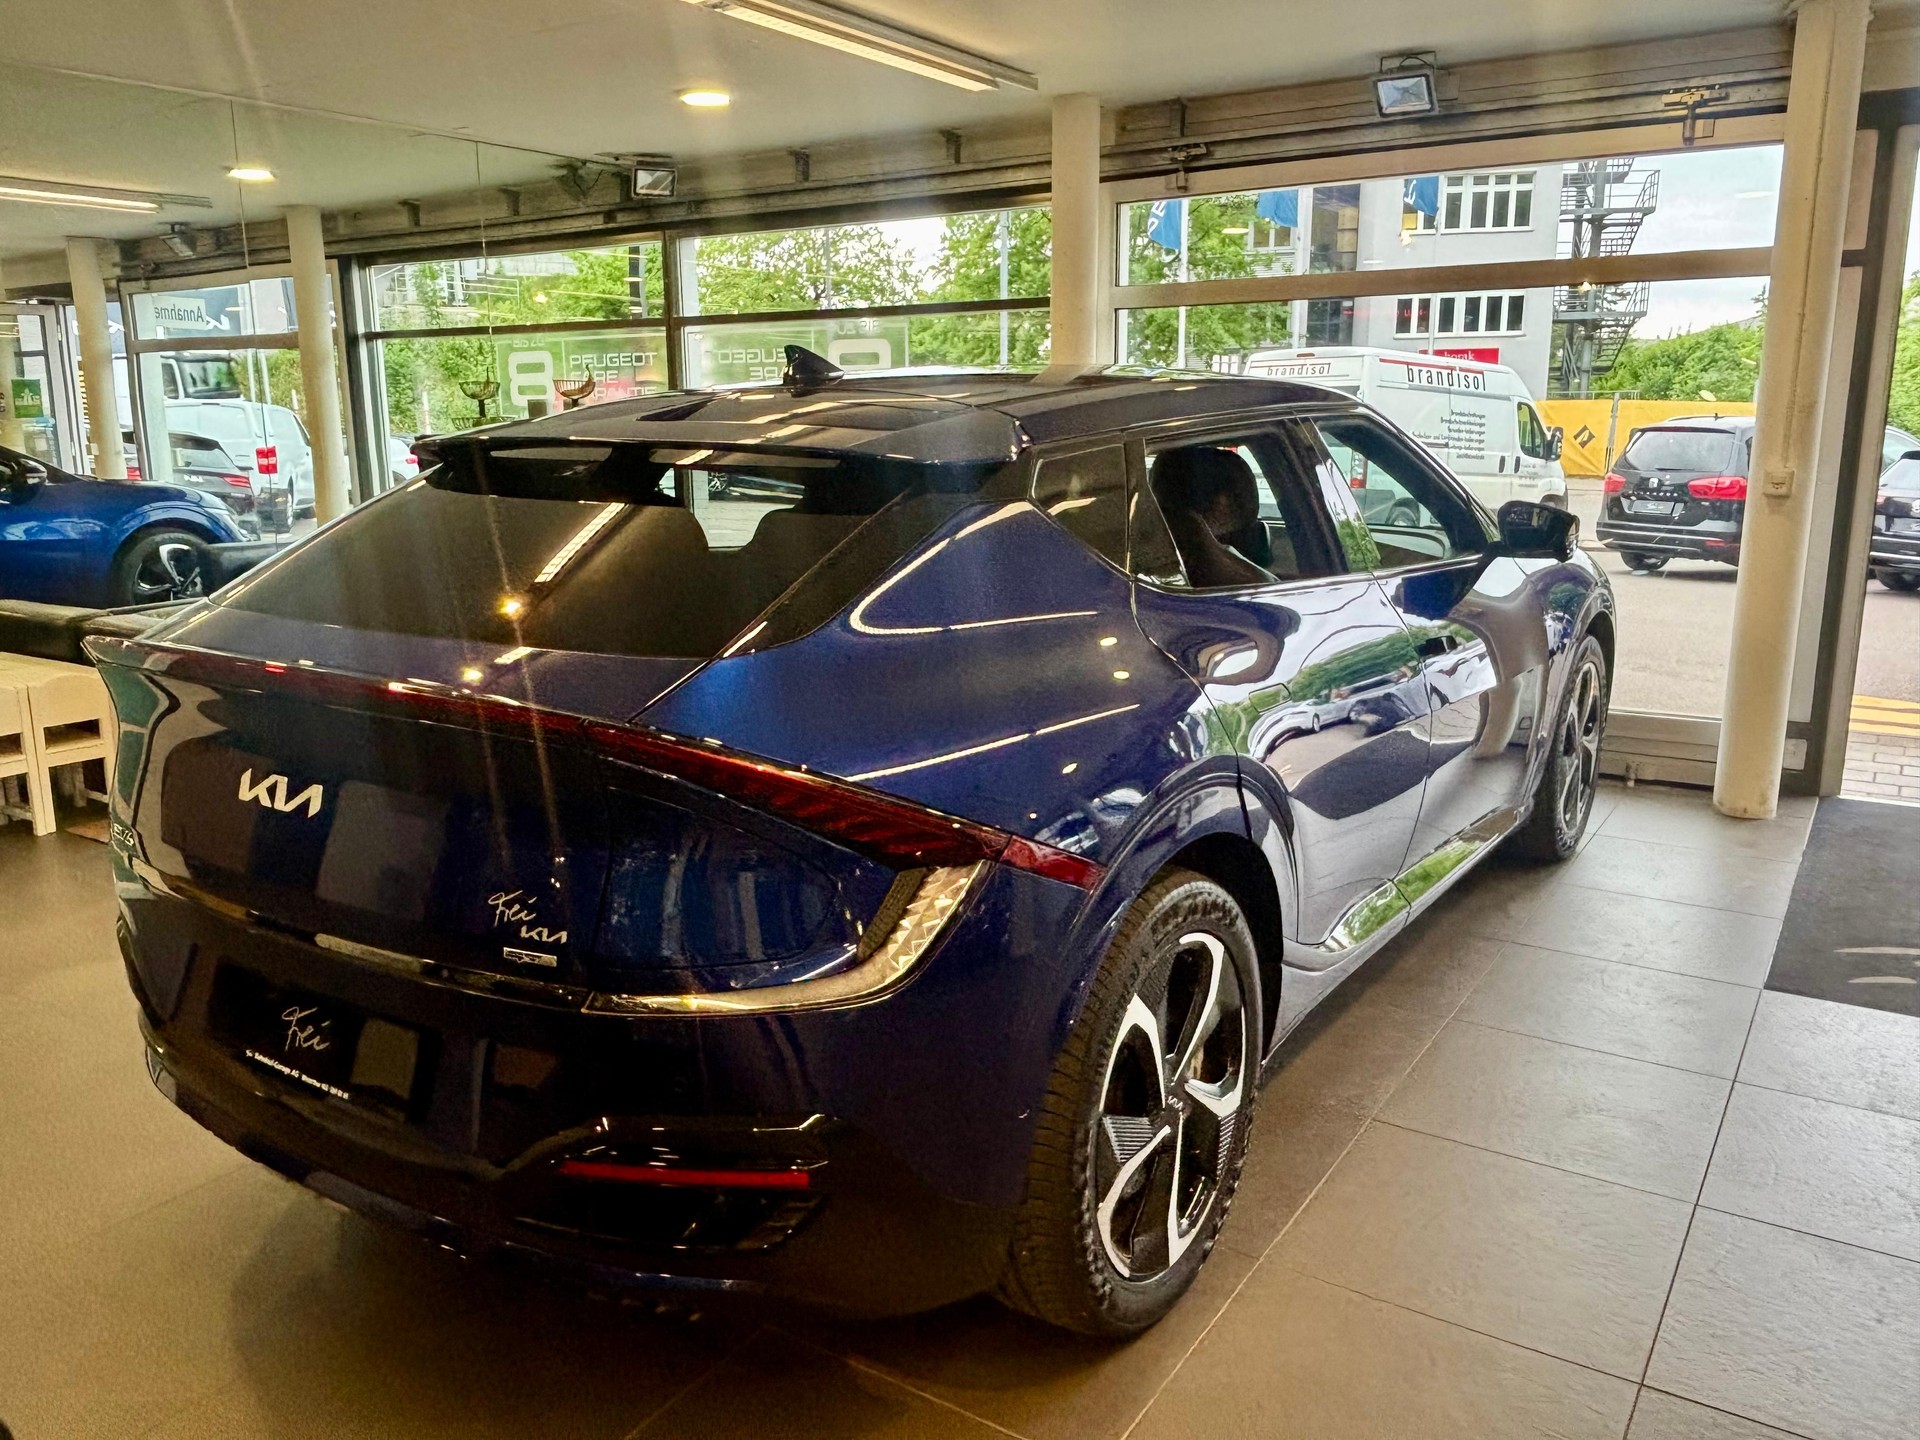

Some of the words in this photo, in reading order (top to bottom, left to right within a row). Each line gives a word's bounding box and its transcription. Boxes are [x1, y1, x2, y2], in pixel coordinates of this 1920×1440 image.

[569, 352, 658, 368] PEUGEOT
[1267, 363, 1331, 376] brandisol
[1406, 364, 1486, 391] brandisol
[238, 768, 323, 818] KIA
